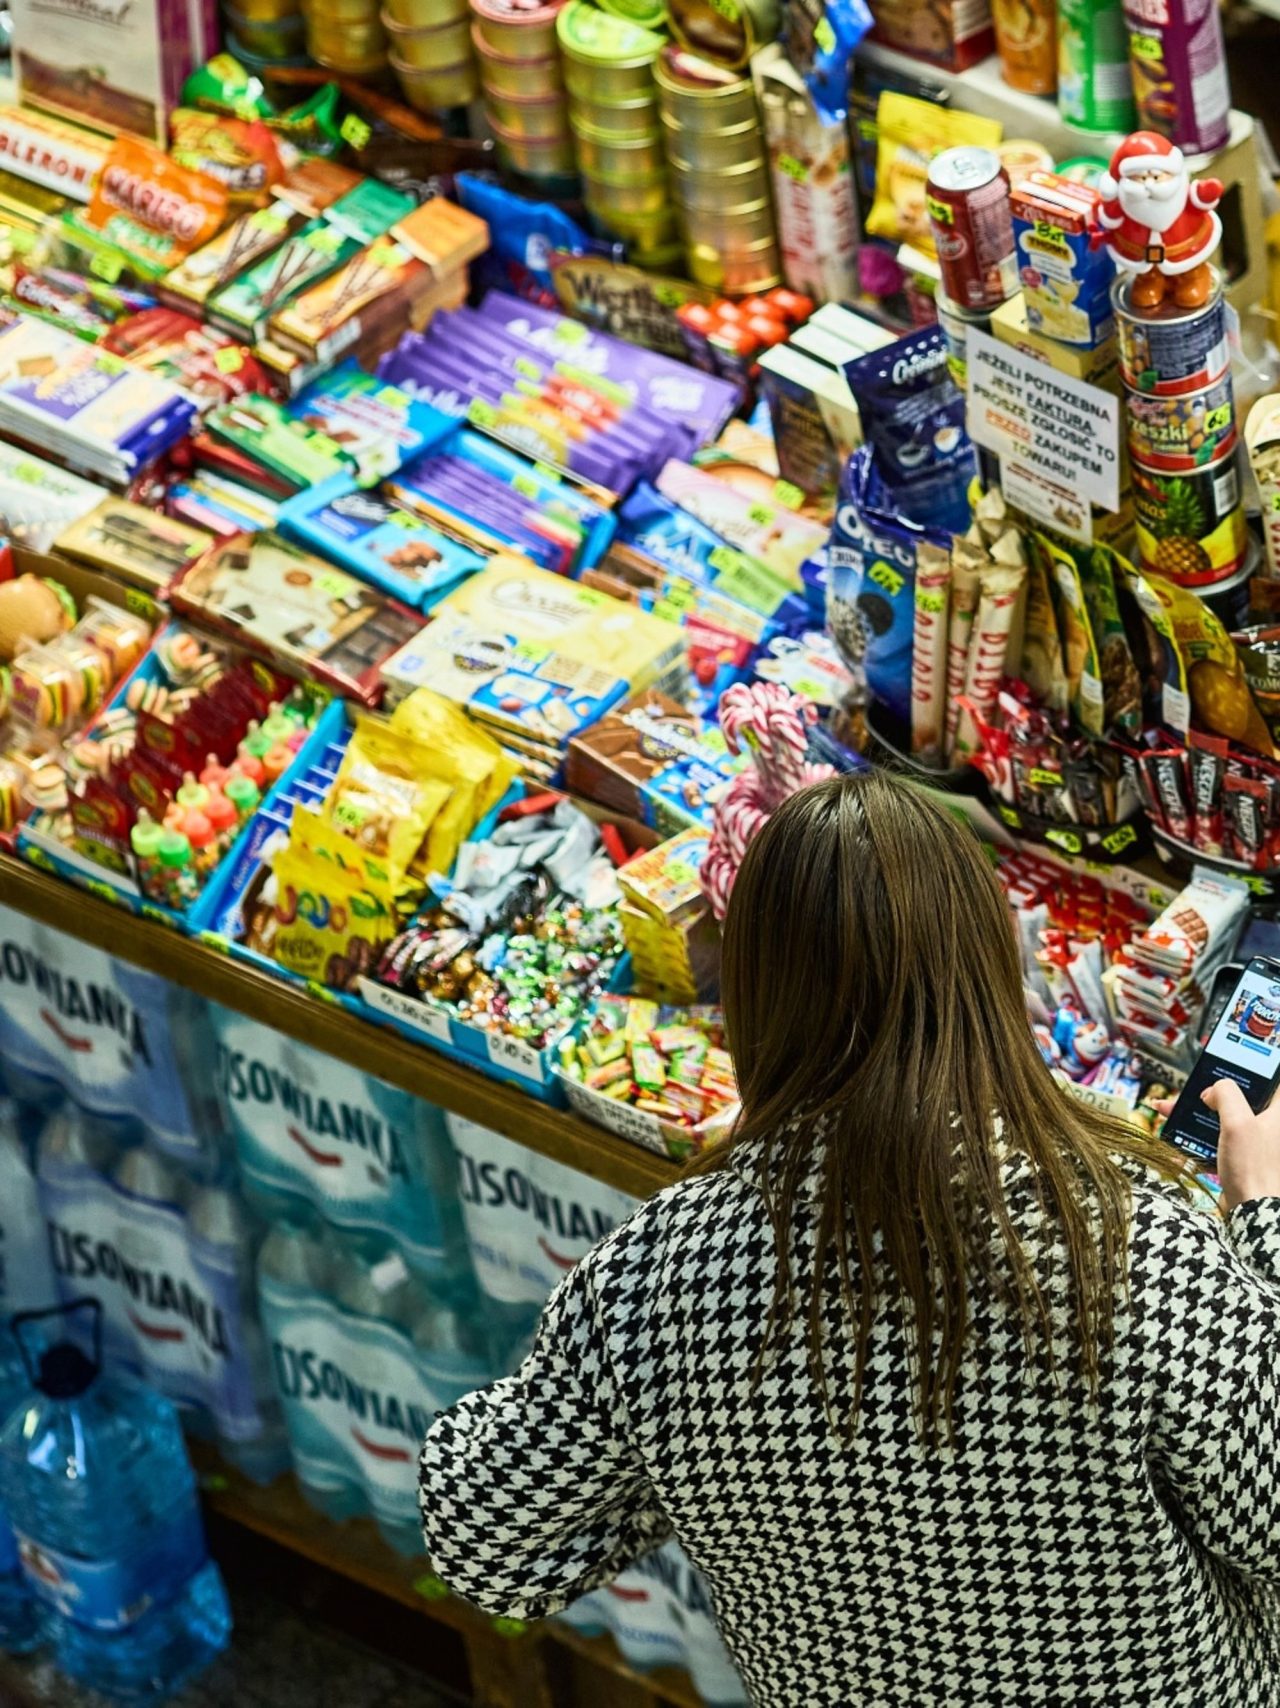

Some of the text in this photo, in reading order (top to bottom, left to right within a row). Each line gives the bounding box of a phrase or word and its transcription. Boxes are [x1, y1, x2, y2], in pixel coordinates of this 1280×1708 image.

[975, 349, 1023, 381] JEŻELI
[1024, 364, 1112, 422] POTRZEBNA
[991, 374, 1024, 399] JEST
[1011, 440, 1076, 480] TOWARU!
[1030, 411, 1092, 452] ZGŁOSIĆ
[1095, 443, 1115, 463] TO
[1034, 429, 1103, 475] ZAKUPEM
